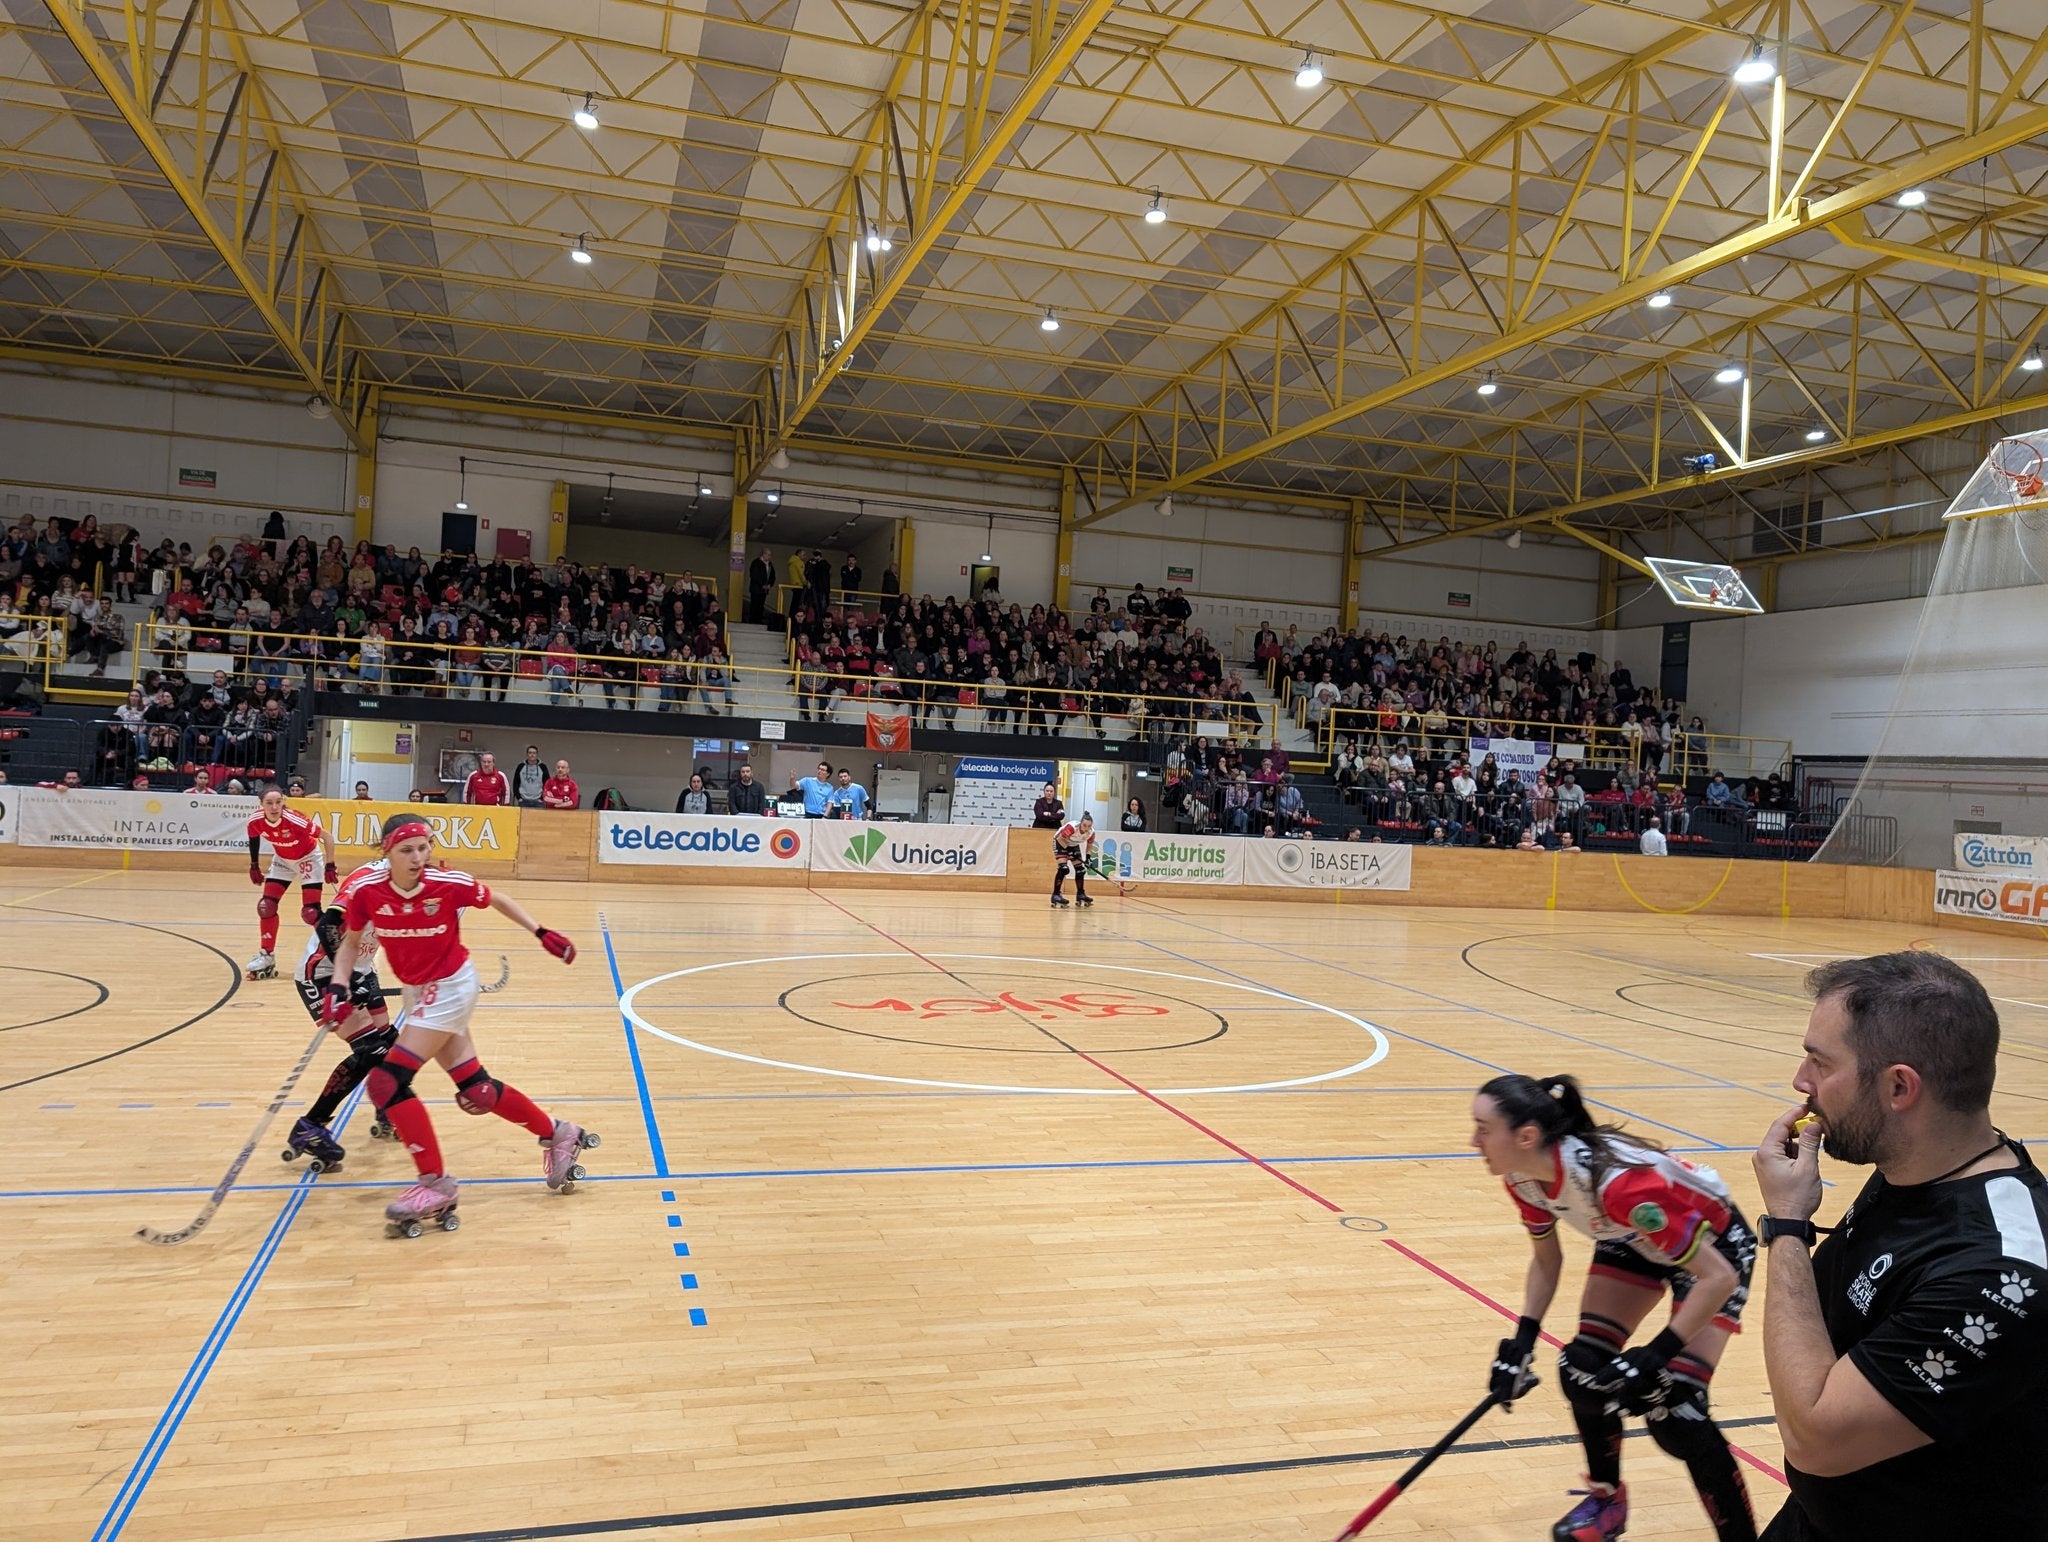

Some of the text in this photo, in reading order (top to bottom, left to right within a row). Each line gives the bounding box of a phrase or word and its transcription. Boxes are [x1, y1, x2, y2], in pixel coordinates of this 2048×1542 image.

[961, 763, 1047, 775] telecable hockey club
[114, 820, 190, 834] INTAICA
[610, 824, 760, 852] telecable
[50, 834, 250, 848] INSTALACIÓN DE PANELES FOTOVOLTAICOS
[1143, 838, 1226, 864] Asturias
[299, 860, 313, 874] 95
[891, 843, 977, 871] Unicaja
[1968, 845, 2033, 866] Zitrón
[1187, 867, 1225, 878] natural
[1308, 874, 1381, 886] CLÍNICA
[1851, 1278, 1873, 1307] SKATE
[1858, 1270, 1878, 1297] WORLD
[1847, 1286, 1868, 1317] EUROPE
[1981, 1288, 2029, 1319] KELME
[1943, 1327, 1988, 1359] KELME
[1904, 1358, 1945, 1394] KELME
